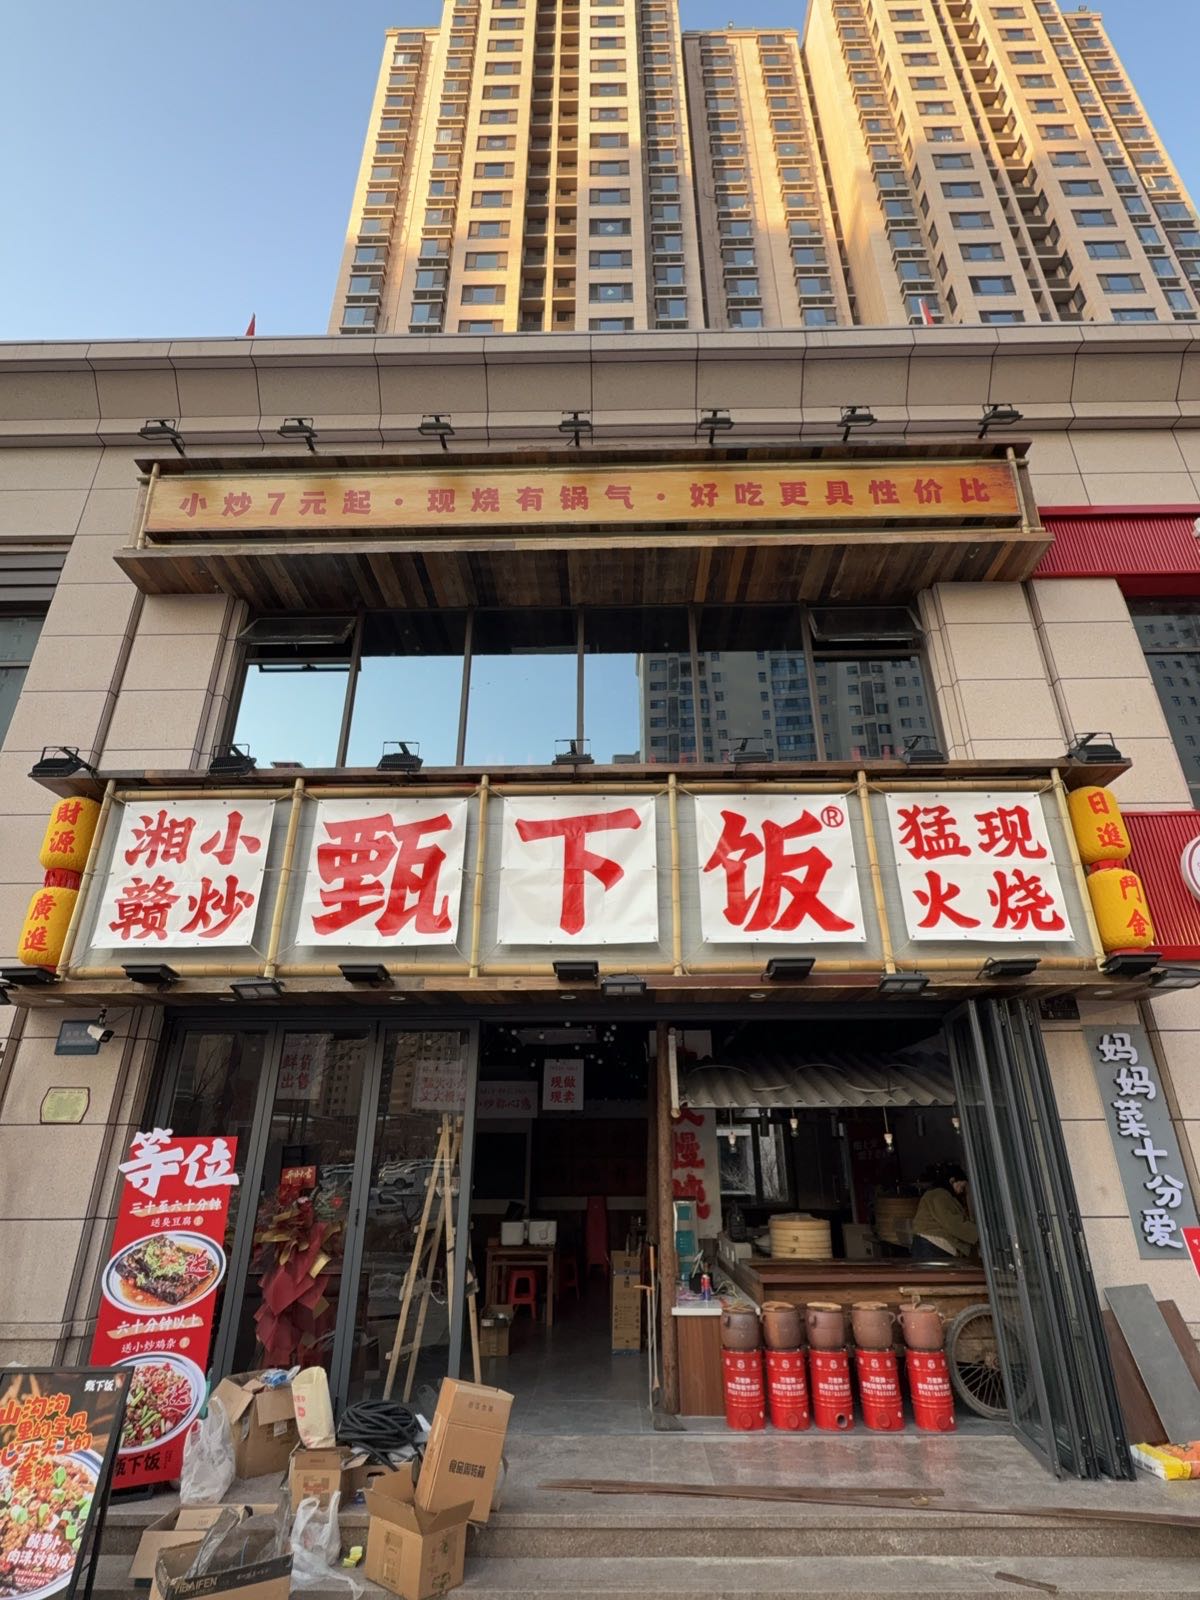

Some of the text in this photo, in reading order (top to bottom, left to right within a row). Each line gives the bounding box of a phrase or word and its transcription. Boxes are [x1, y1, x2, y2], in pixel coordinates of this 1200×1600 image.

[49, 800, 83, 854] 財源
[1088, 791, 1126, 849] 日進
[23, 893, 57, 952] 廣進
[118, 1127, 240, 1198] 等位
[1099, 1033, 1184, 1249] 妈妈菜十分爱
[115, 1314, 203, 1335] 六十分钟以上
[120, 1337, 177, 1354] 送小炒鸡杂
[0, 1392, 71, 1425] 山沟沟
[16, 1410, 88, 1441] 里的宝贝
[14, 1461, 54, 1488] 美味
